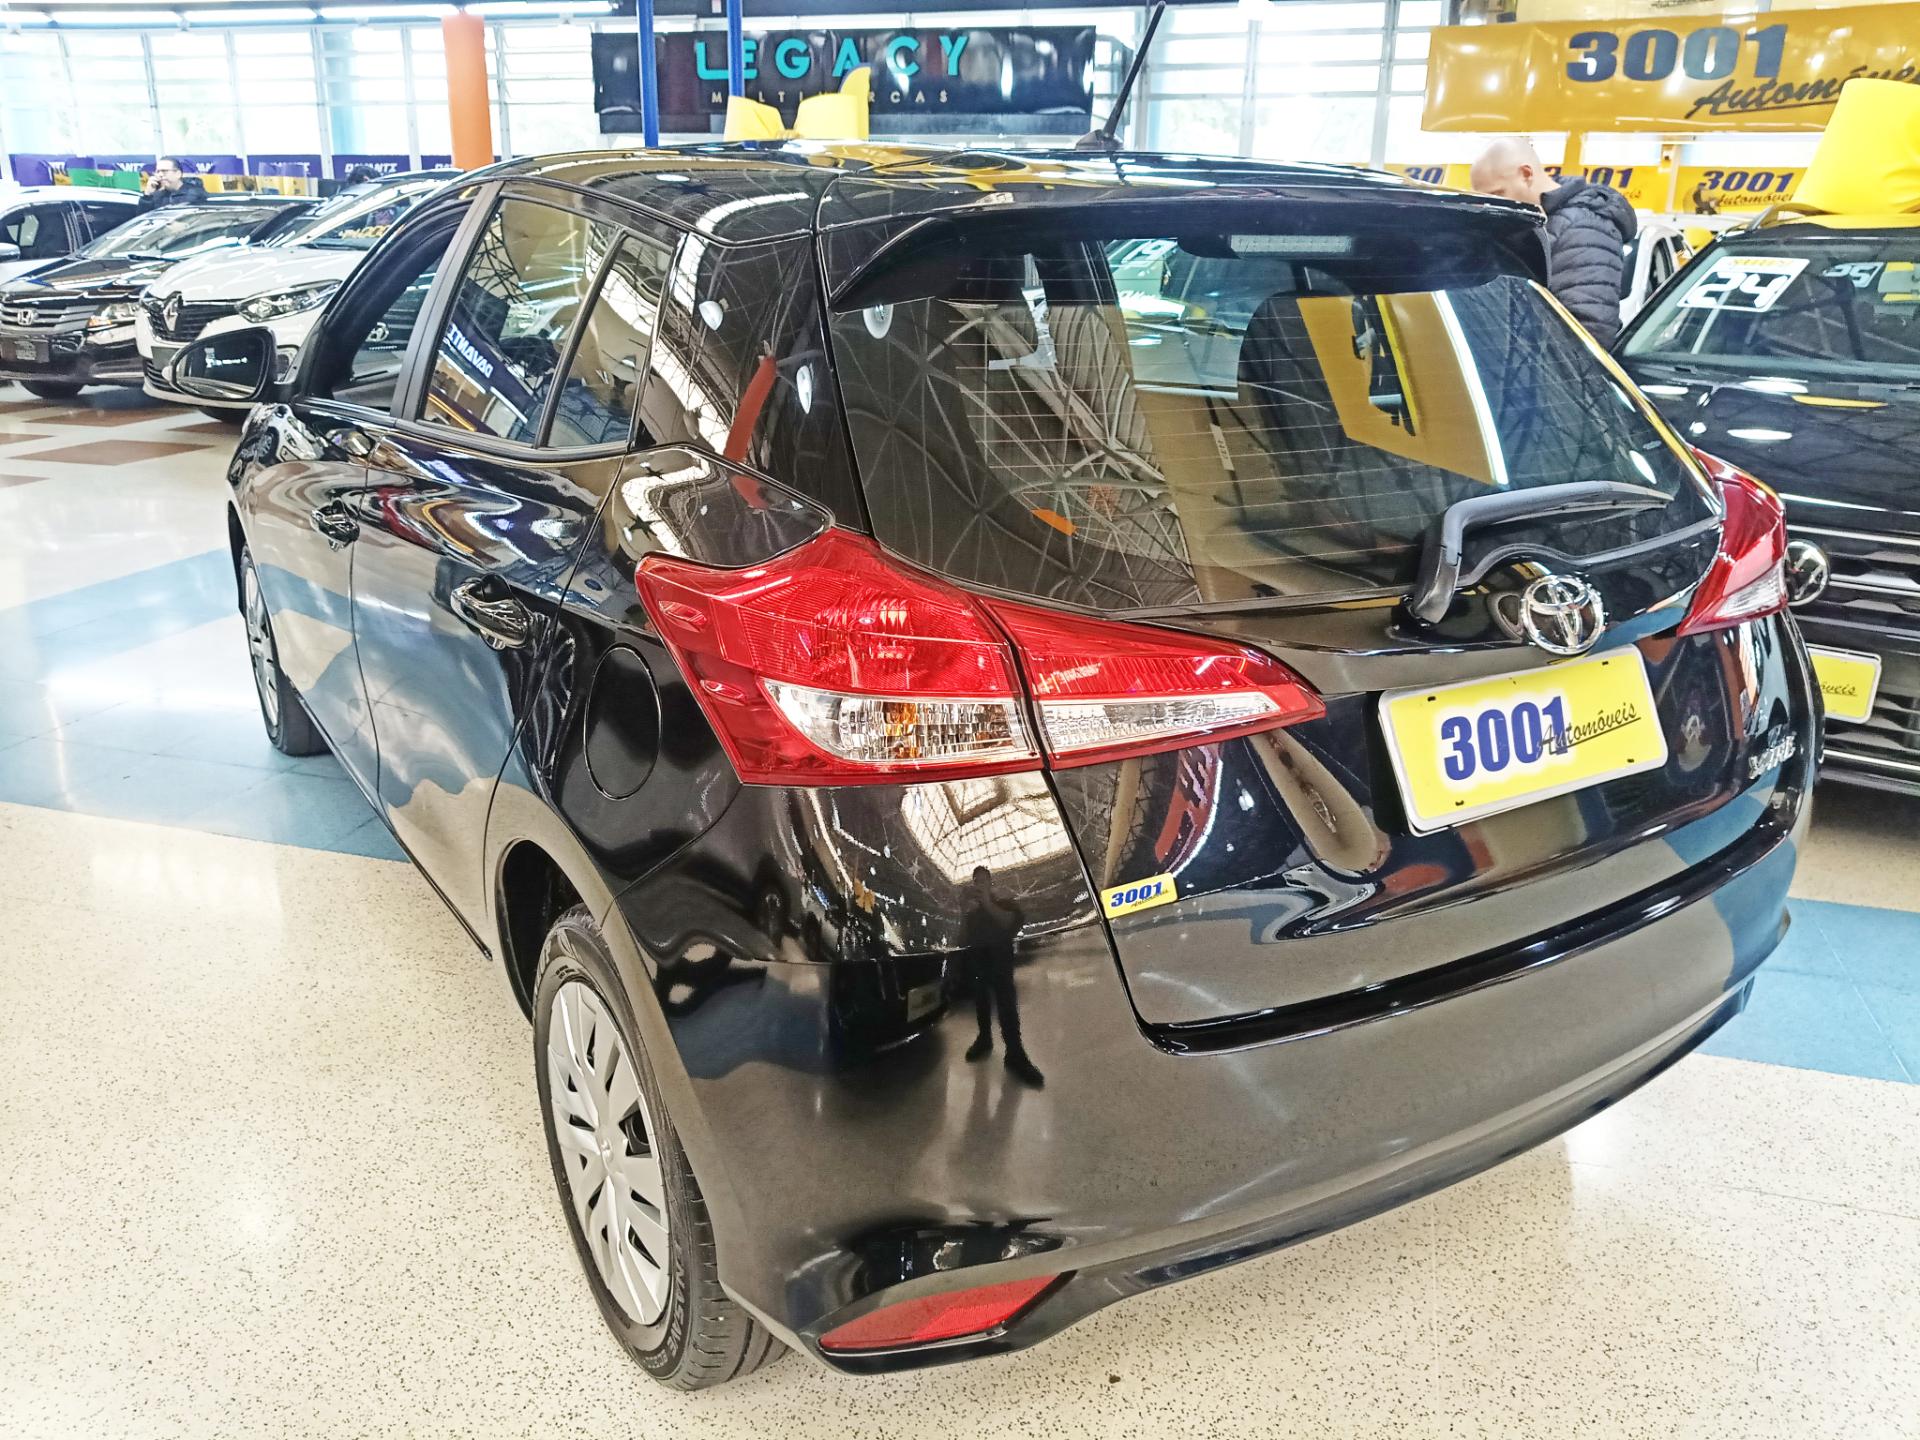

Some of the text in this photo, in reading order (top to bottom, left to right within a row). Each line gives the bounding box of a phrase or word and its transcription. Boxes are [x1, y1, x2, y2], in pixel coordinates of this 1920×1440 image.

[696, 35, 969, 81] LEGACY
[1566, 23, 1789, 83] 3001
[711, 90, 949, 104] MLTIRCAS
[1702, 170, 1795, 193] 3001
[1685, 271, 1790, 308] 24
[1441, 695, 1641, 781] 3001 Automóveis
[1110, 881, 1163, 908] 3001
